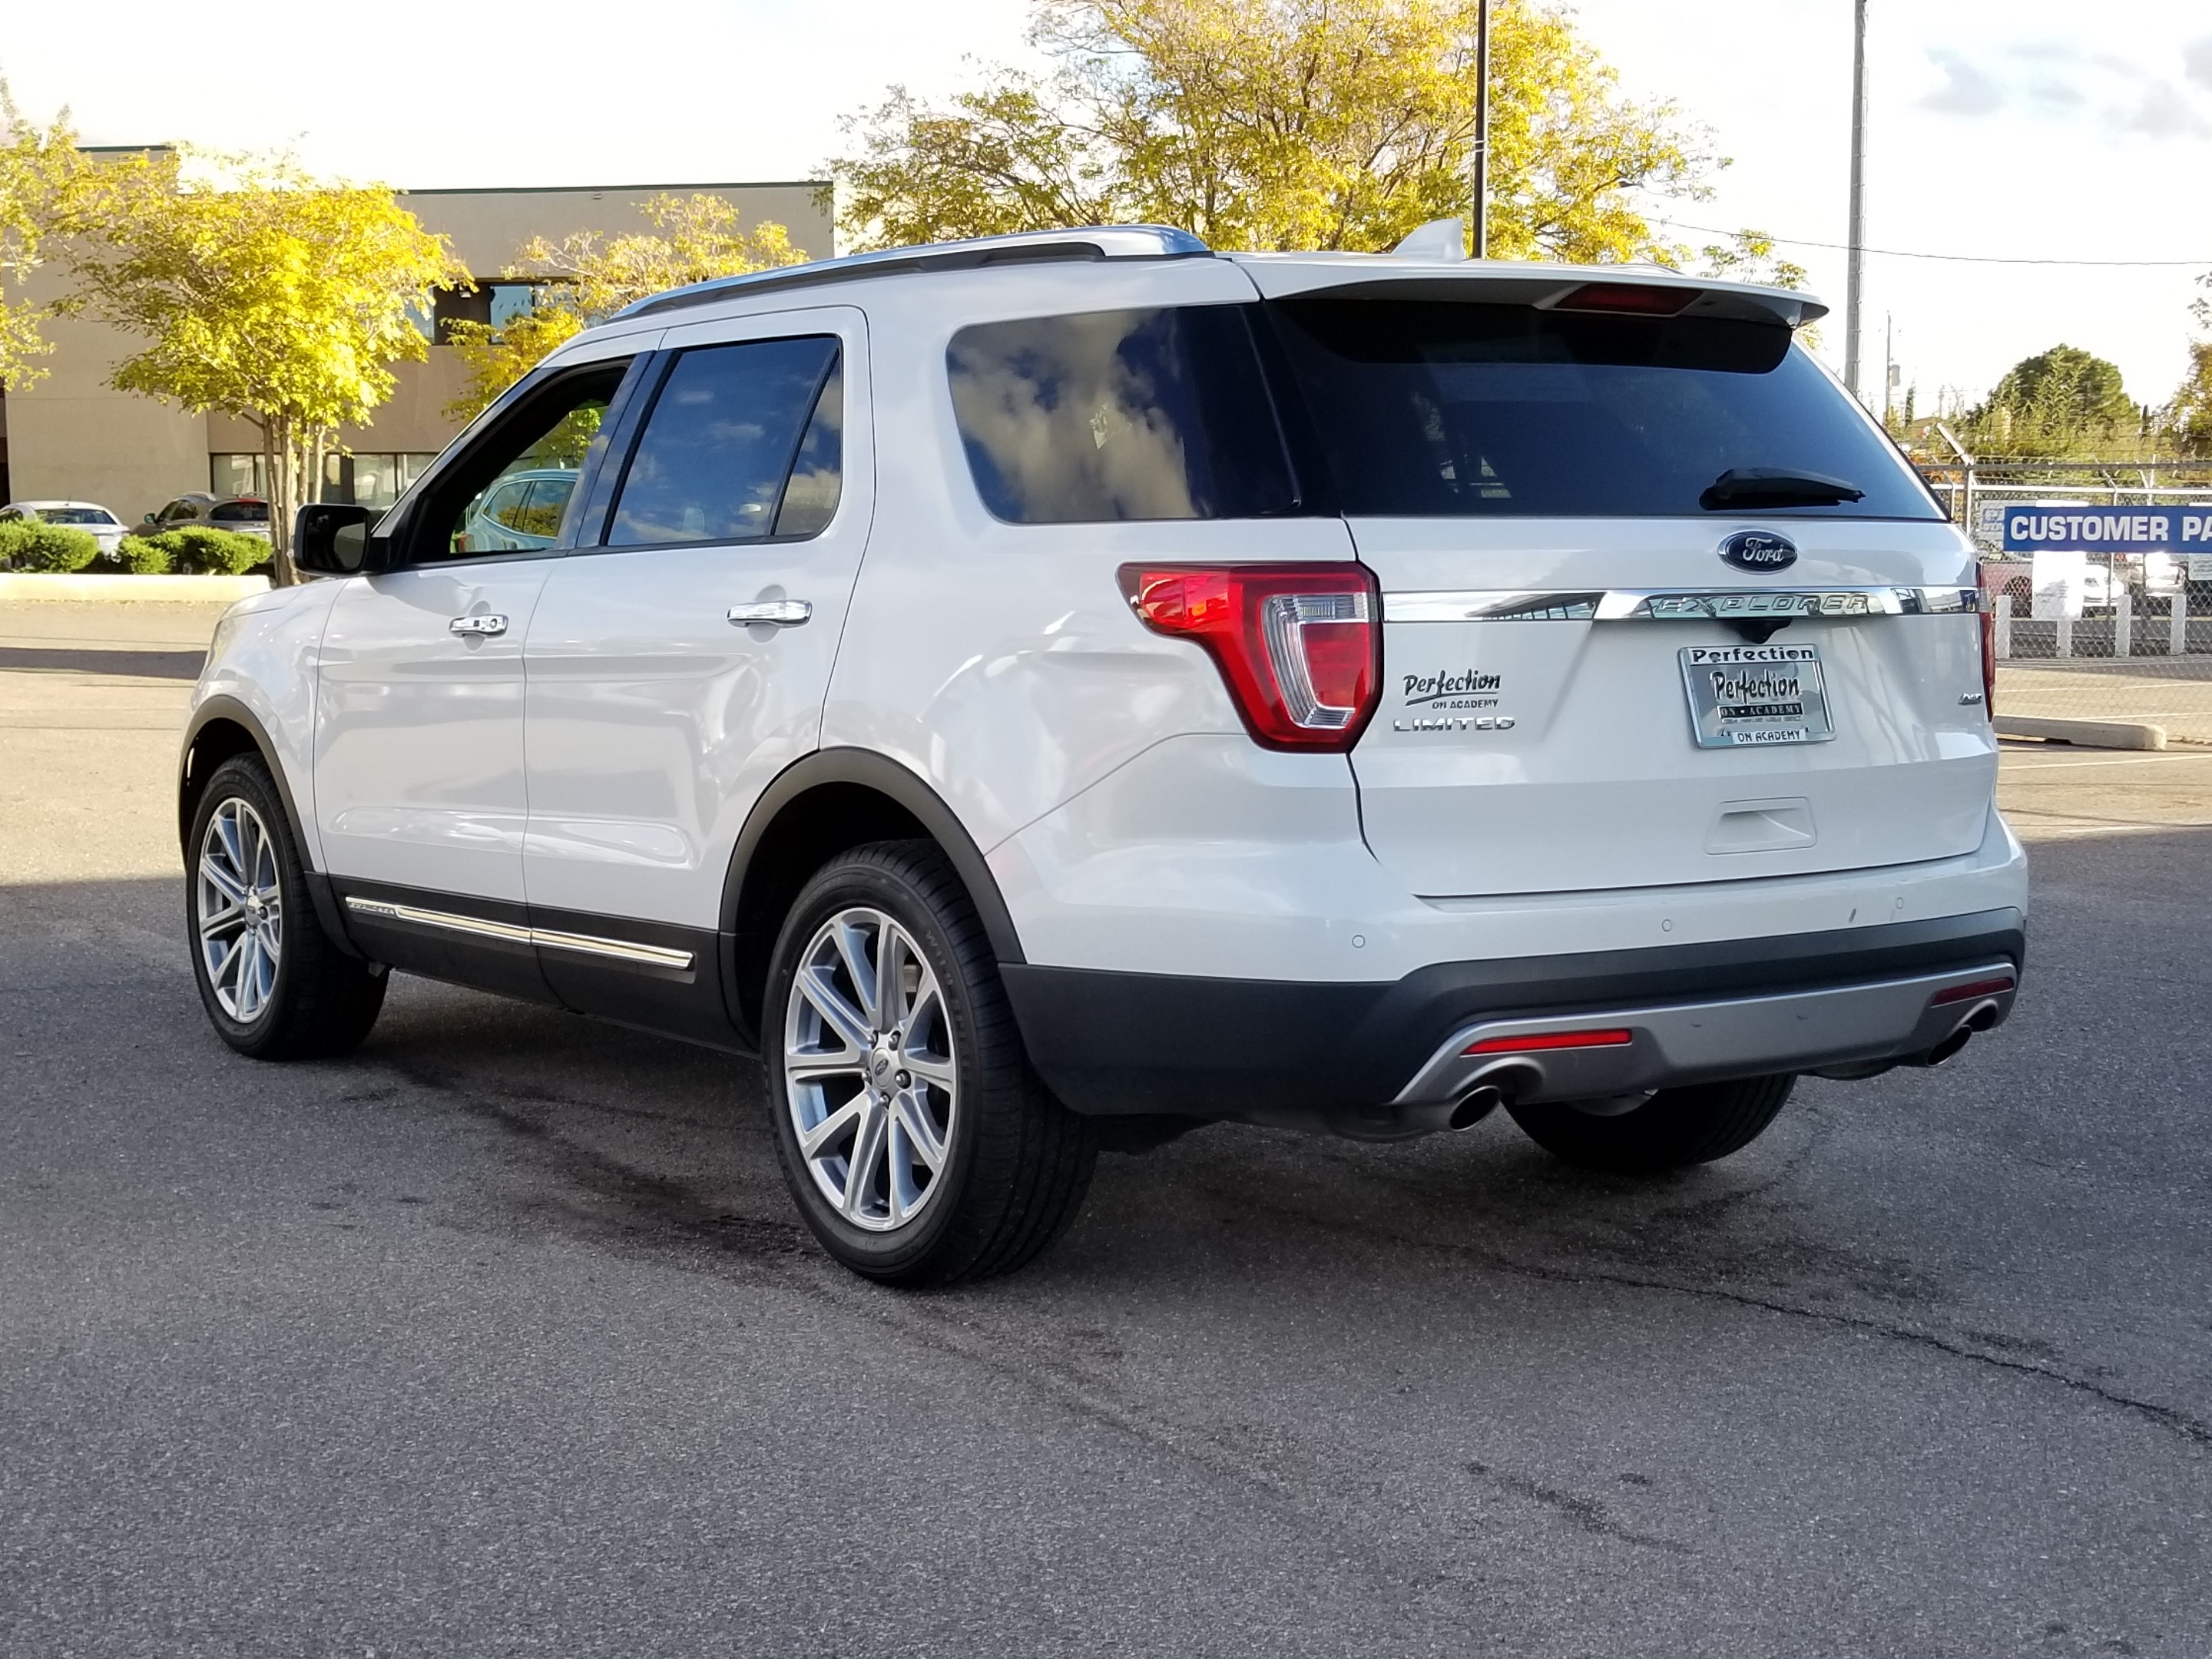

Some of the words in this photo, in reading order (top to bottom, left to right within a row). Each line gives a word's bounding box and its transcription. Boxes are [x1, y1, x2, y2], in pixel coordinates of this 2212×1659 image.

[2011, 515, 2170, 541] CUSTOMER
[1742, 537, 1785, 562] Ford
[1657, 594, 1869, 614] EXPLORER
[1691, 647, 1813, 663] Perfection
[1402, 668, 1502, 697] Perfection
[1710, 668, 1800, 705] Perfection
[1432, 700, 1447, 710] ON
[1449, 699, 1498, 709] ACADEMY
[1720, 707, 1736, 717] ON
[1749, 704, 1801, 716] ACADEMY
[1393, 717, 1515, 731] LIMITED
[1737, 732, 1753, 743] ON
[1755, 730, 1800, 742] ACADEMY
